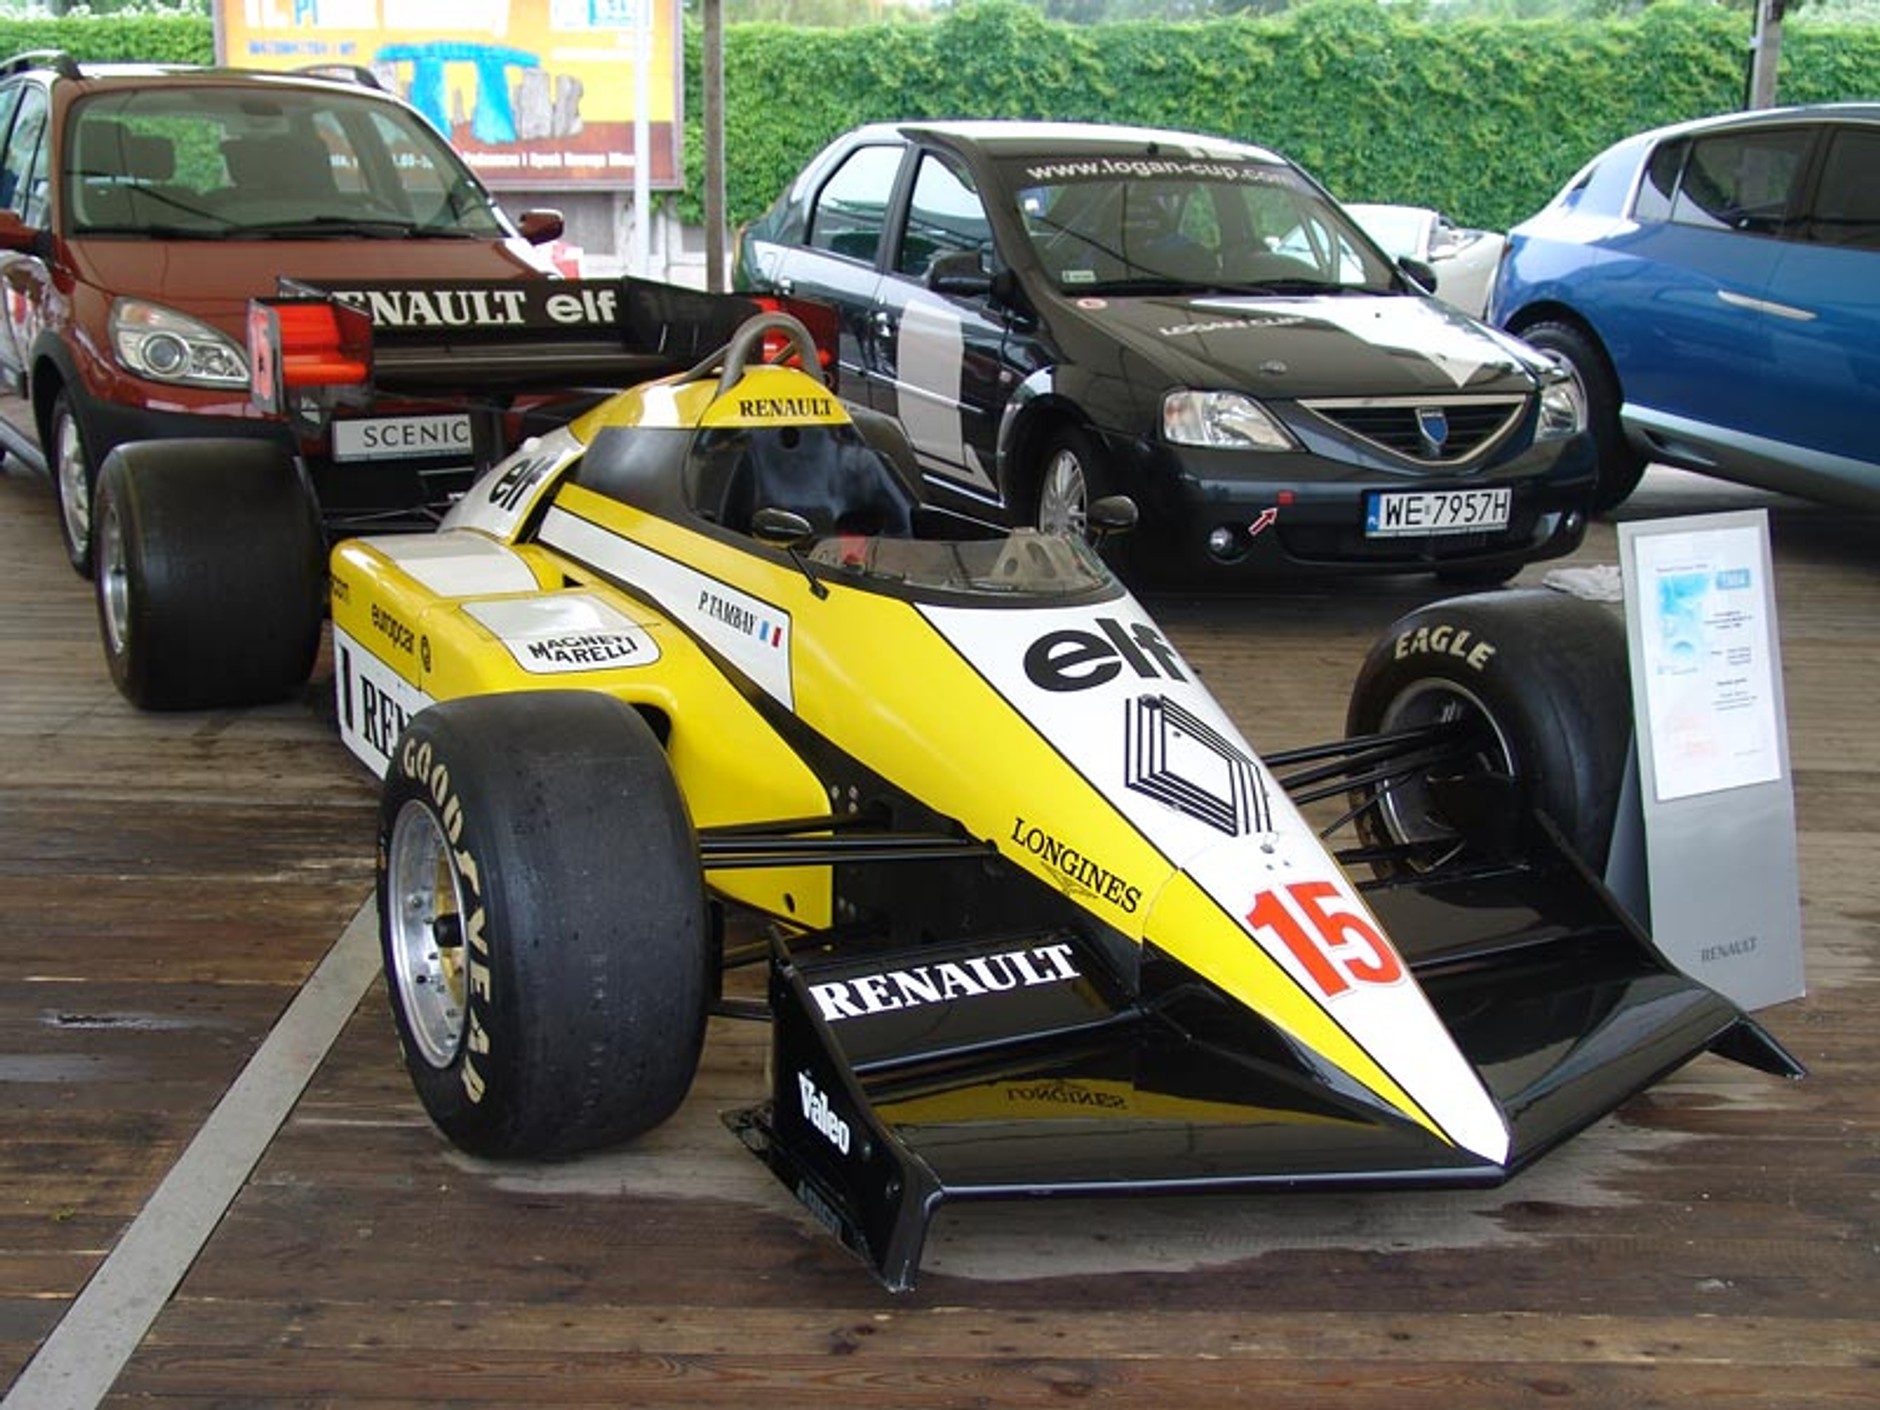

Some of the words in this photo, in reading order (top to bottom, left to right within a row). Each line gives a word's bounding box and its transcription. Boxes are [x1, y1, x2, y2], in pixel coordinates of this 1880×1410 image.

[546, 290, 617, 323] elf
[363, 421, 469, 447] SCENIC
[738, 398, 832, 417] RENAULT
[489, 456, 557, 511] elf
[1023, 617, 1188, 692] elf
[1394, 624, 1497, 671] EAGLE
[1011, 817, 1142, 913] LONGINES
[1246, 881, 1402, 997] 15
[808, 943, 1081, 1021] RENAULT
[797, 1071, 850, 1156] Valeo
